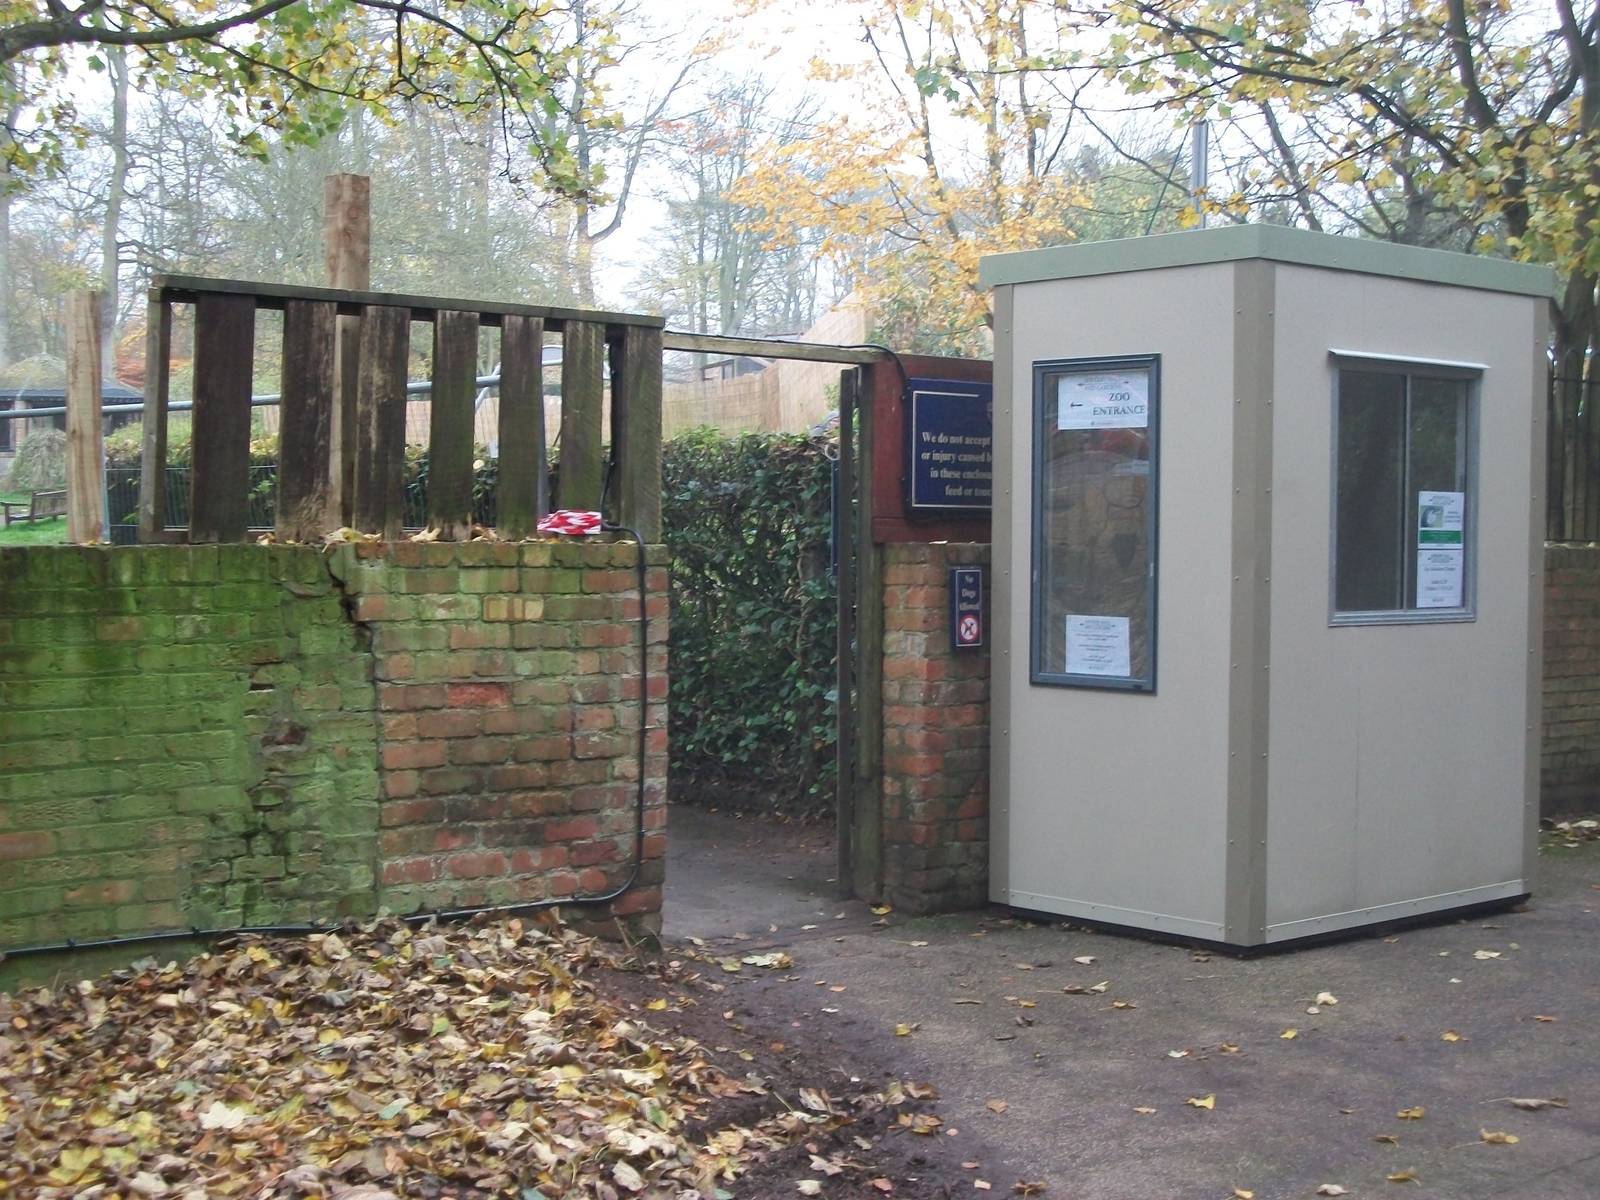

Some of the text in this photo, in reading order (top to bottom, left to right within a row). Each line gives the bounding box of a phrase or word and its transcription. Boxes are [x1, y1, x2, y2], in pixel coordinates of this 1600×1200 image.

[1109, 392, 1130, 402] ZOO
[1092, 405, 1145, 416] ENTRANCE
[922, 431, 991, 448] We do not accept
[921, 452, 931, 460] or
[932, 449, 957, 463] injury
[958, 452, 985, 462] caused
[930, 467, 938, 478] in
[940, 468, 961, 478] these
[945, 485, 992, 497] feed or touc
